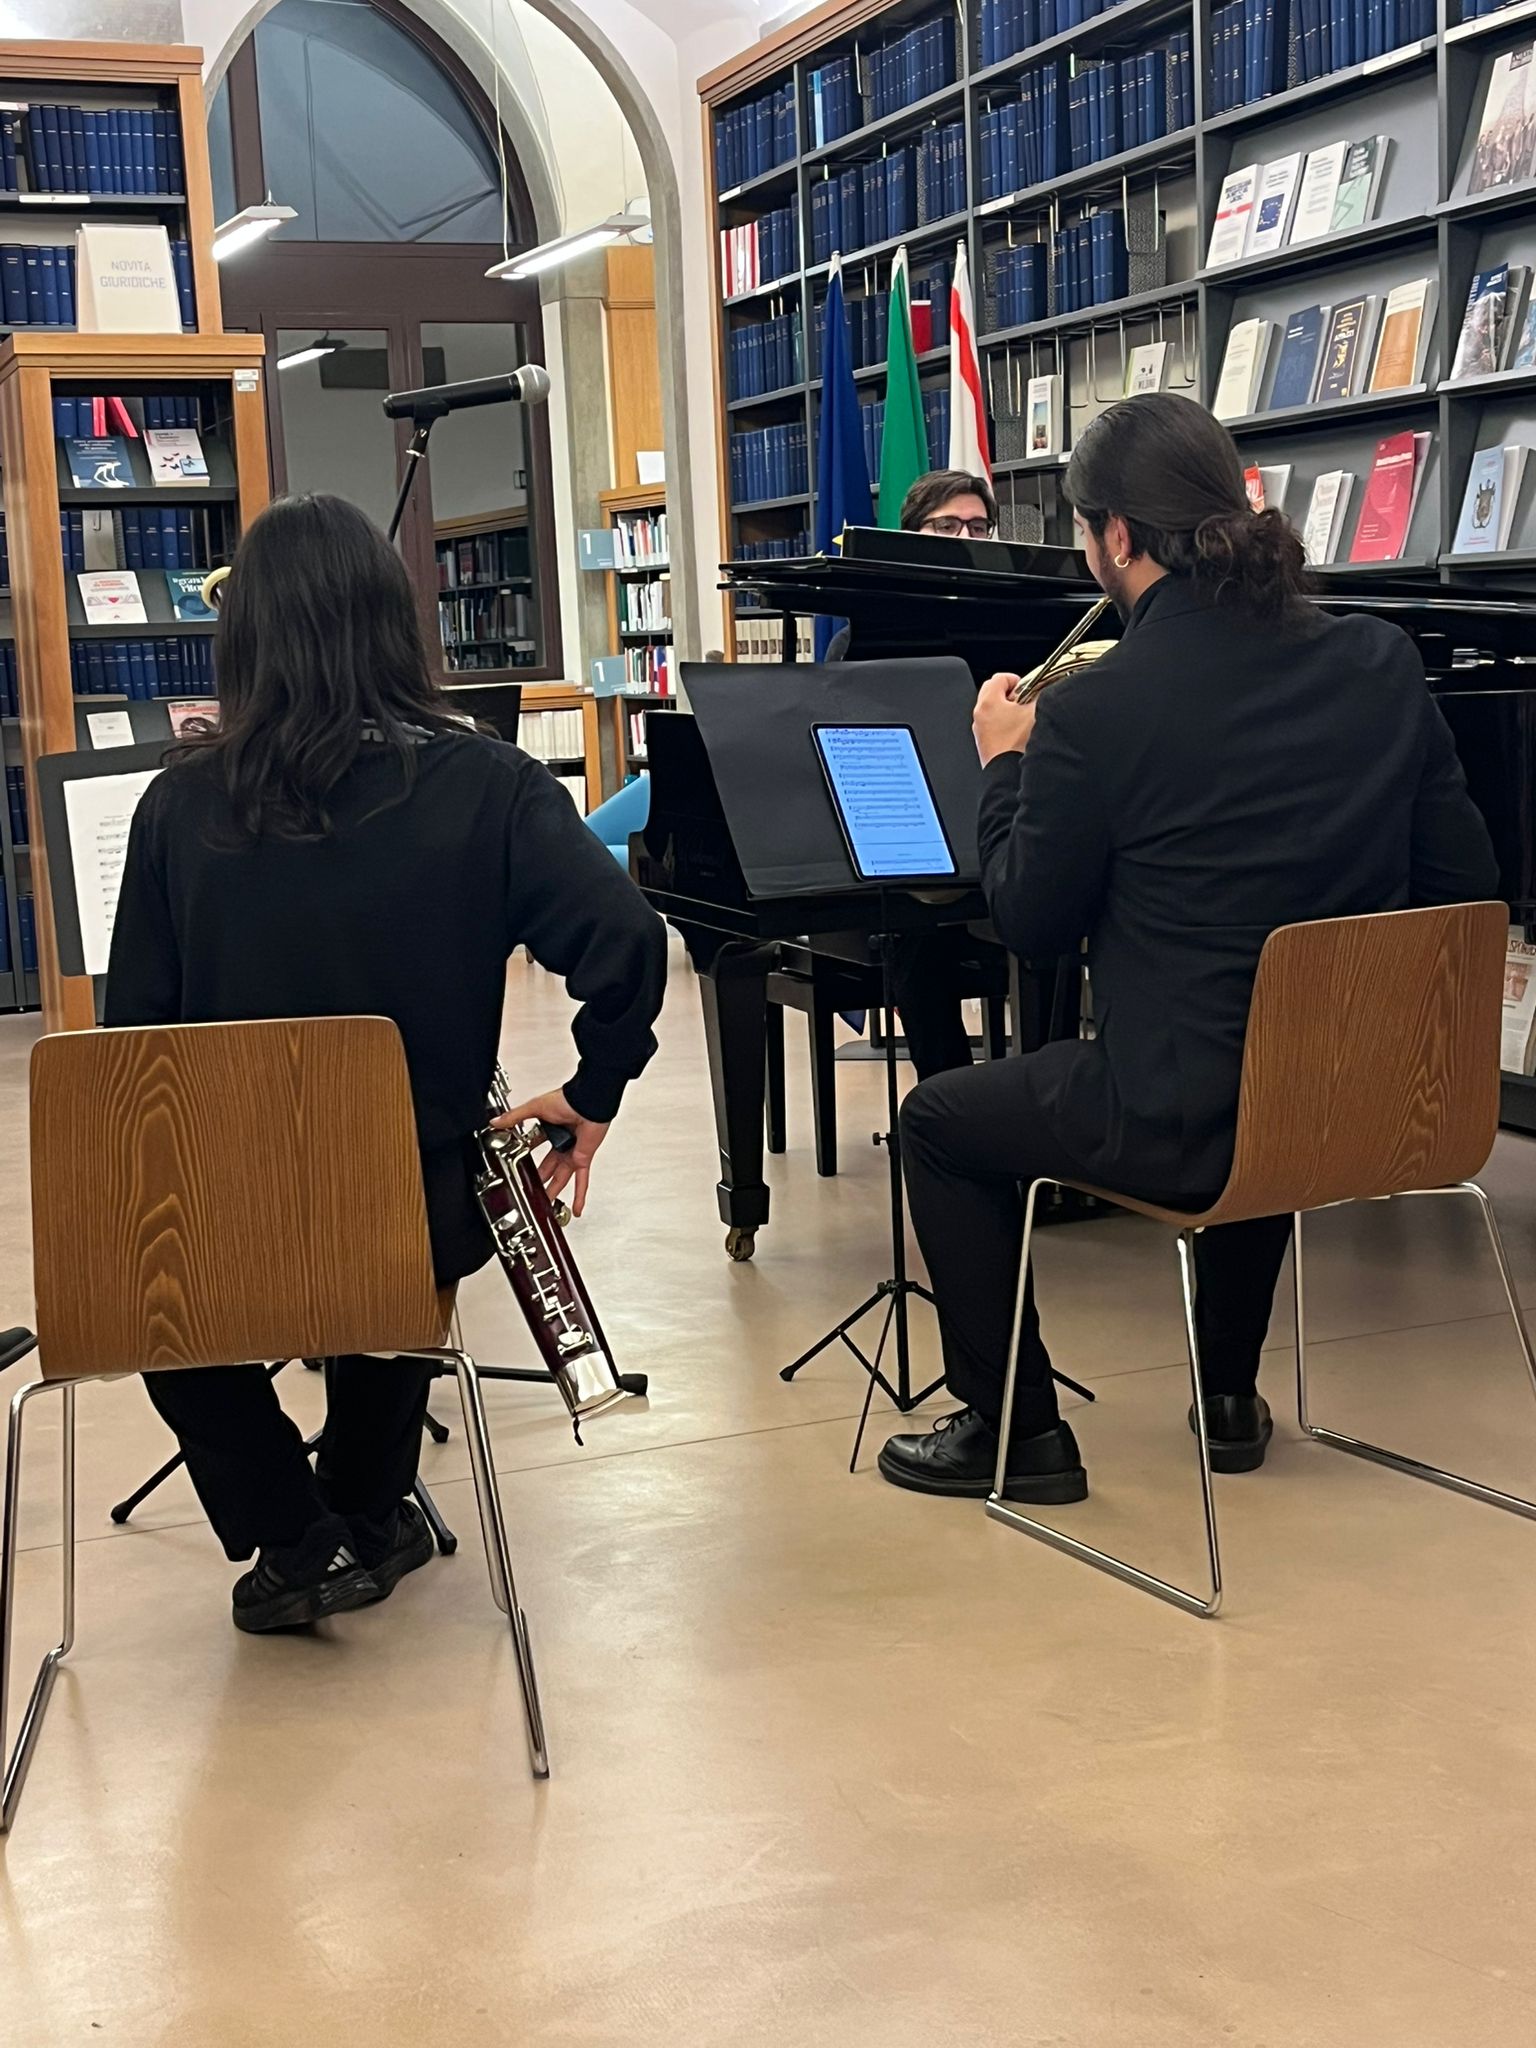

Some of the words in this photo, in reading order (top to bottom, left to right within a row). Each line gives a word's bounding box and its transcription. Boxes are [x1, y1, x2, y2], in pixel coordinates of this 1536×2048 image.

[100, 275, 167, 289] GIURIDICHE
[582, 533, 592, 555] 1
[594, 661, 605, 683] 1
